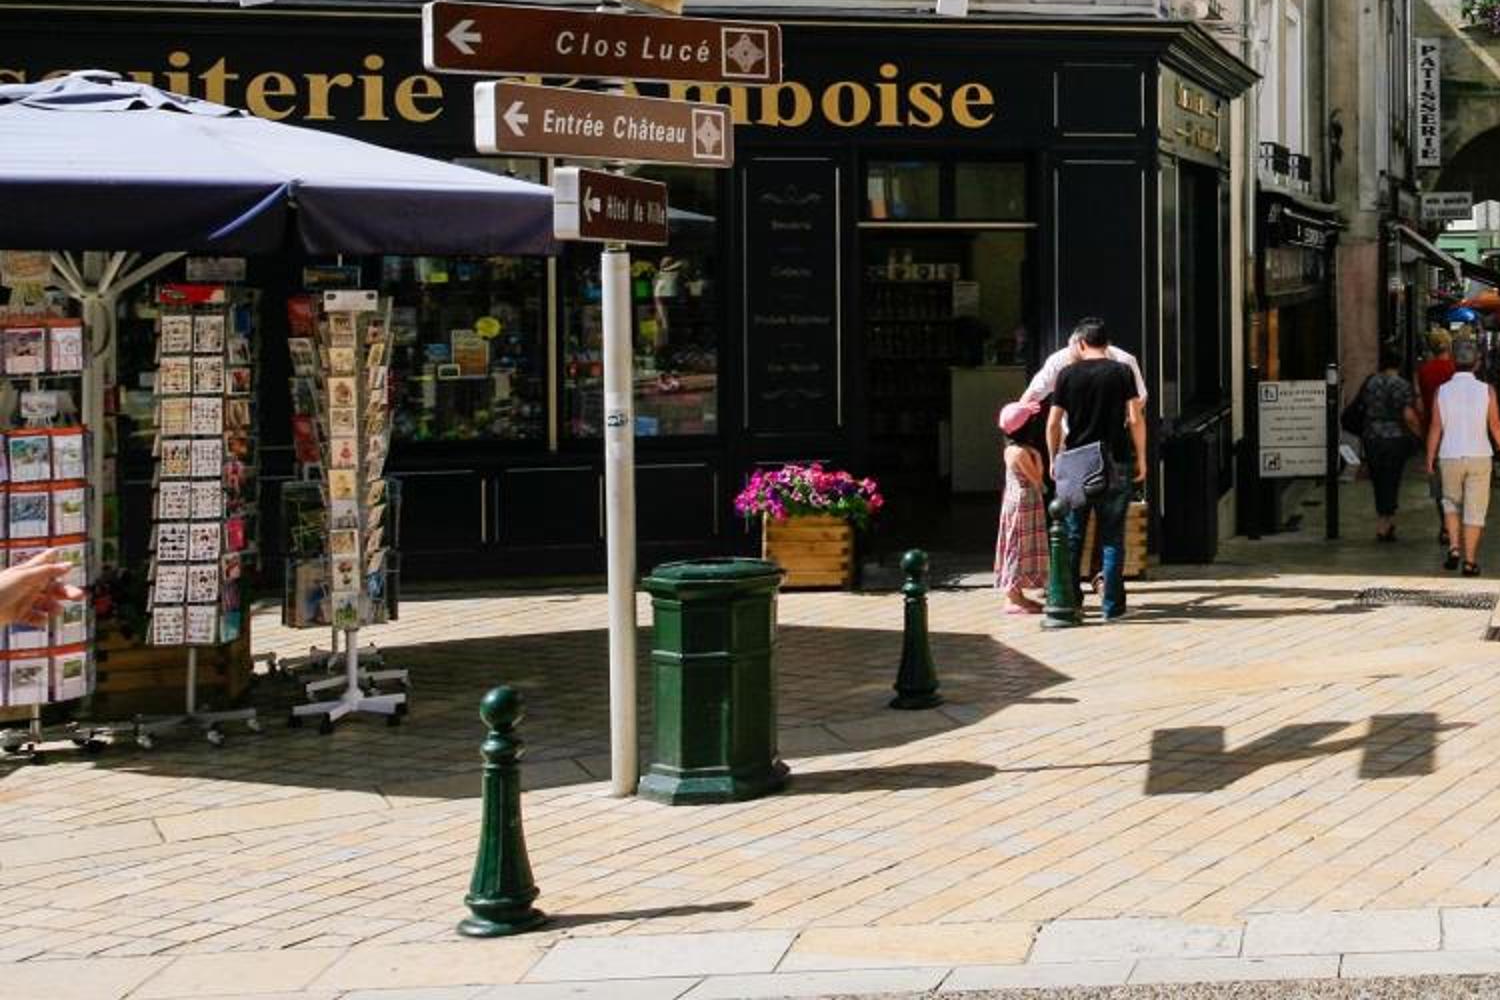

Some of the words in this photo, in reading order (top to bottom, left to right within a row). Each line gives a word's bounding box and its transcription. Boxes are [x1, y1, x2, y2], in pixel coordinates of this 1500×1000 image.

[556, 32, 628, 57] Clos
[642, 36, 711, 62] Lucé
[543, 109, 604, 137] Entrée
[613, 114, 687, 144] Château
